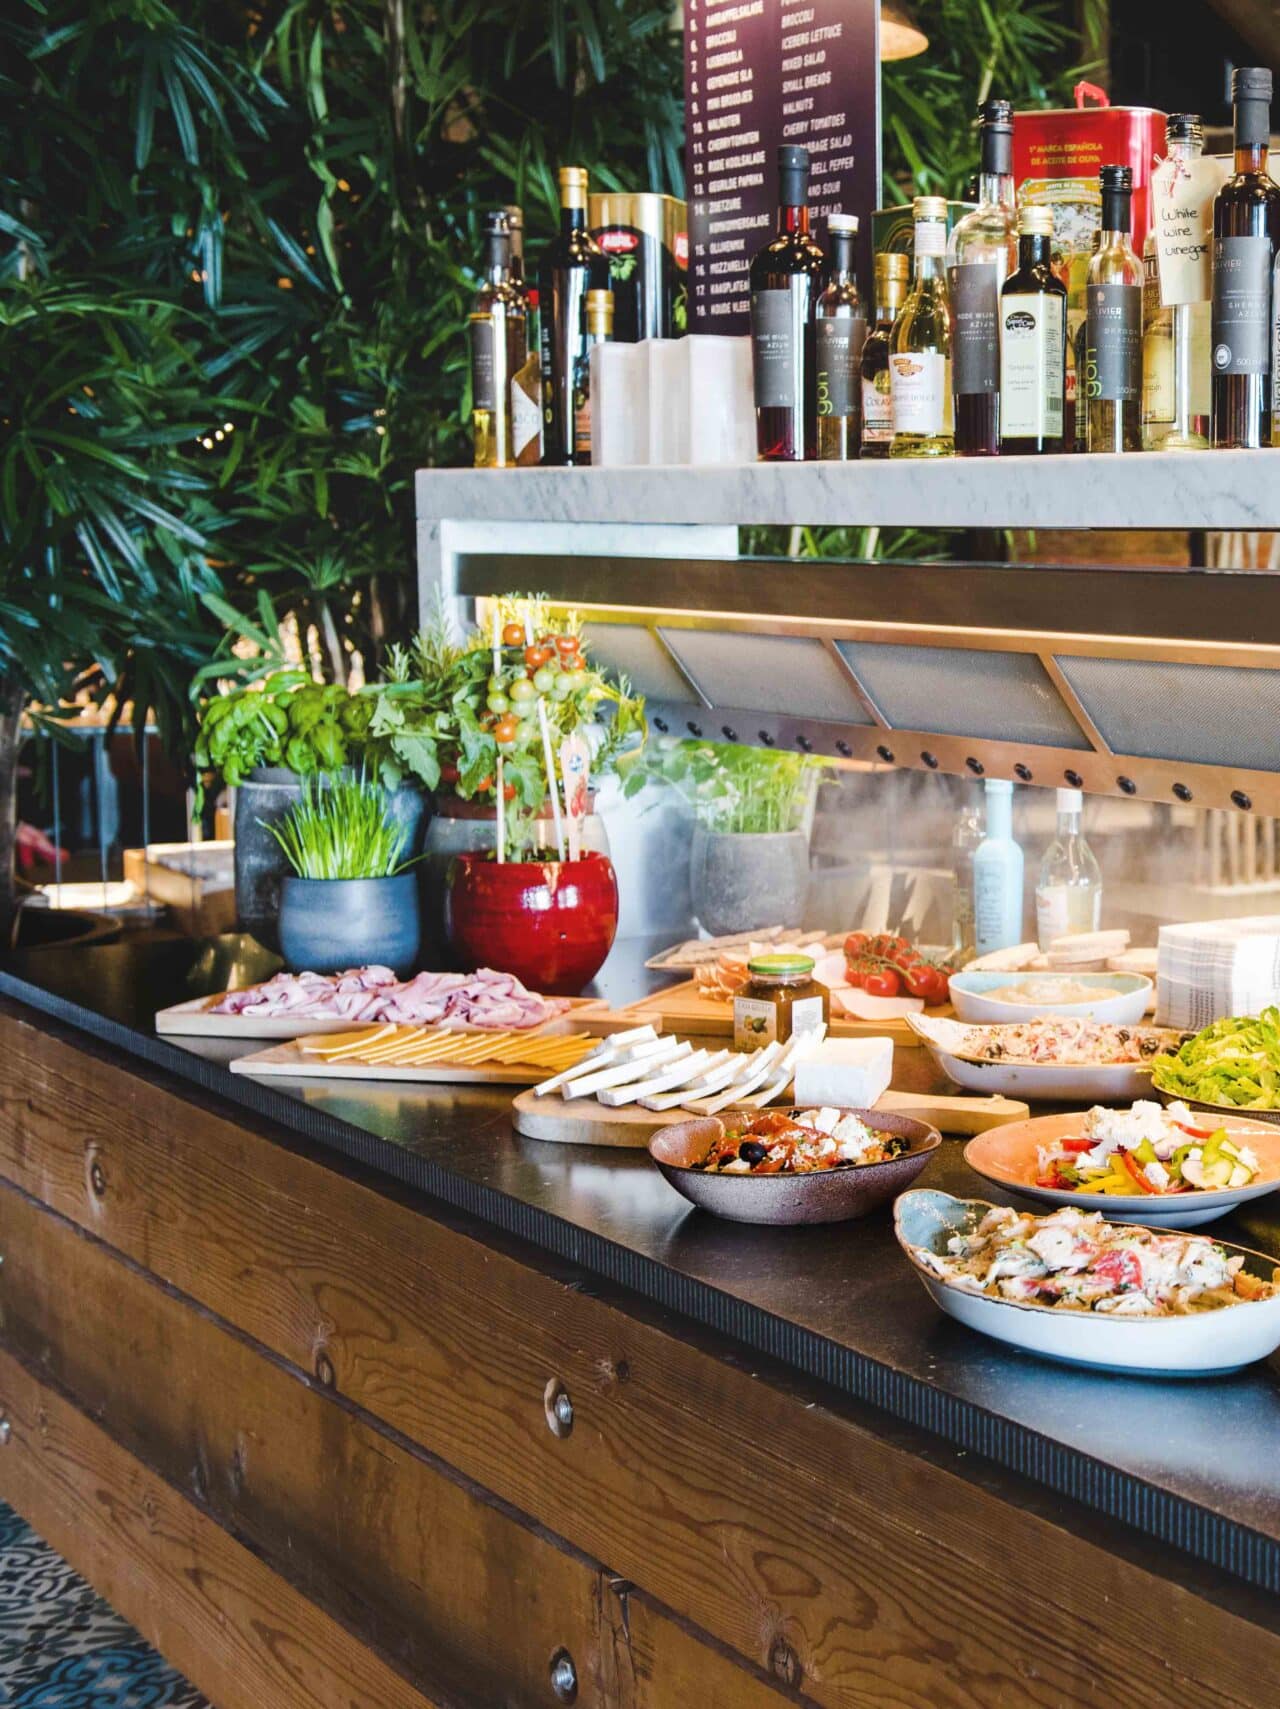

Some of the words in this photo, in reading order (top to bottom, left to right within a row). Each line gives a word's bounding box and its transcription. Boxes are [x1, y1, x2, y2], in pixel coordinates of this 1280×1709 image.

[803, 50, 826, 67] SALAD
[783, 121, 808, 137] CHERRY
[810, 113, 846, 132] TOMATOES
[829, 134, 853, 150] SALAD
[811, 162, 828, 176] BELL
[829, 156, 855, 172] PEPPER
[1162, 208, 1200, 221] White
